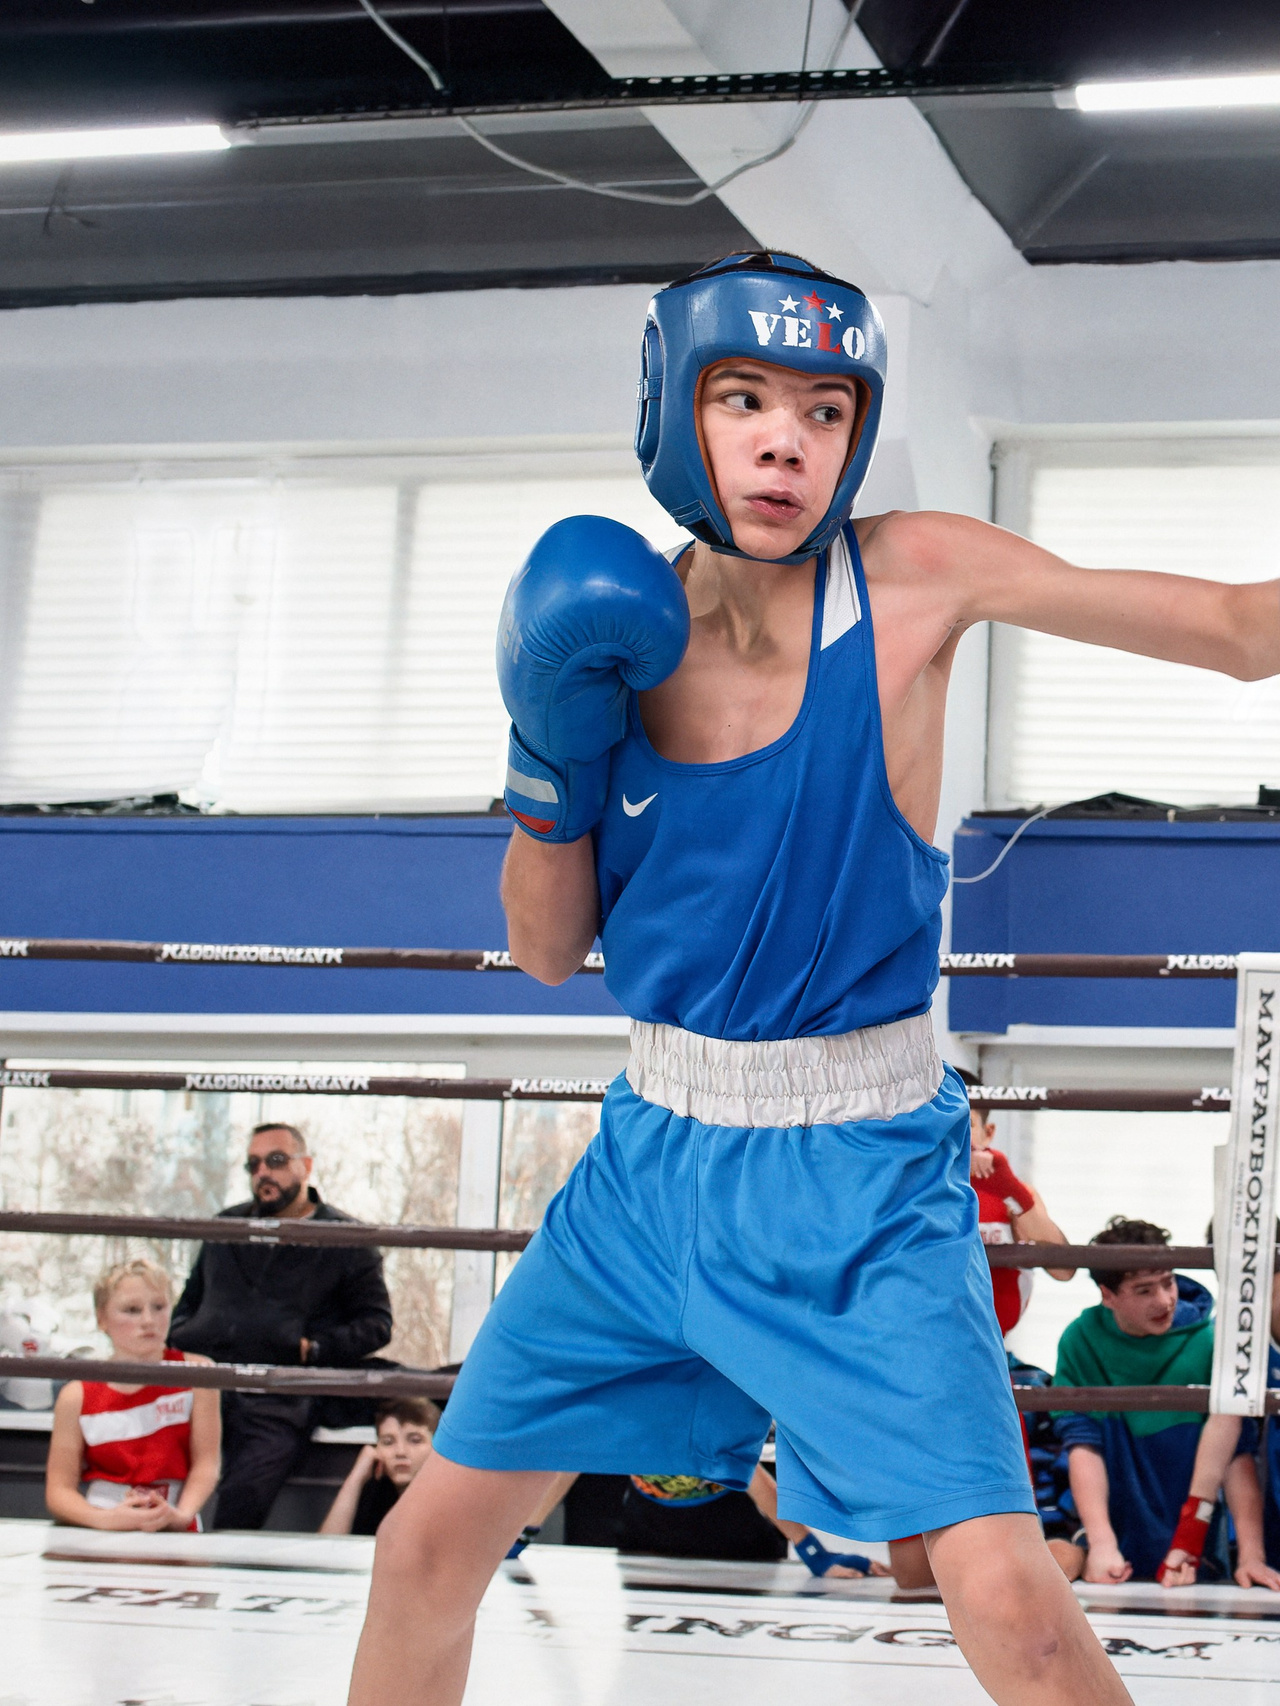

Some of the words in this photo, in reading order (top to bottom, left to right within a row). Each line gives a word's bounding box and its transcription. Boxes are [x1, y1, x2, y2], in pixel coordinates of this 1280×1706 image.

[748, 310, 866, 360] VELO
[184, 1073, 370, 1091] MAYFATBOXINGGYM
[1233, 988, 1275, 1398] MAYFATBOXINGGYM
